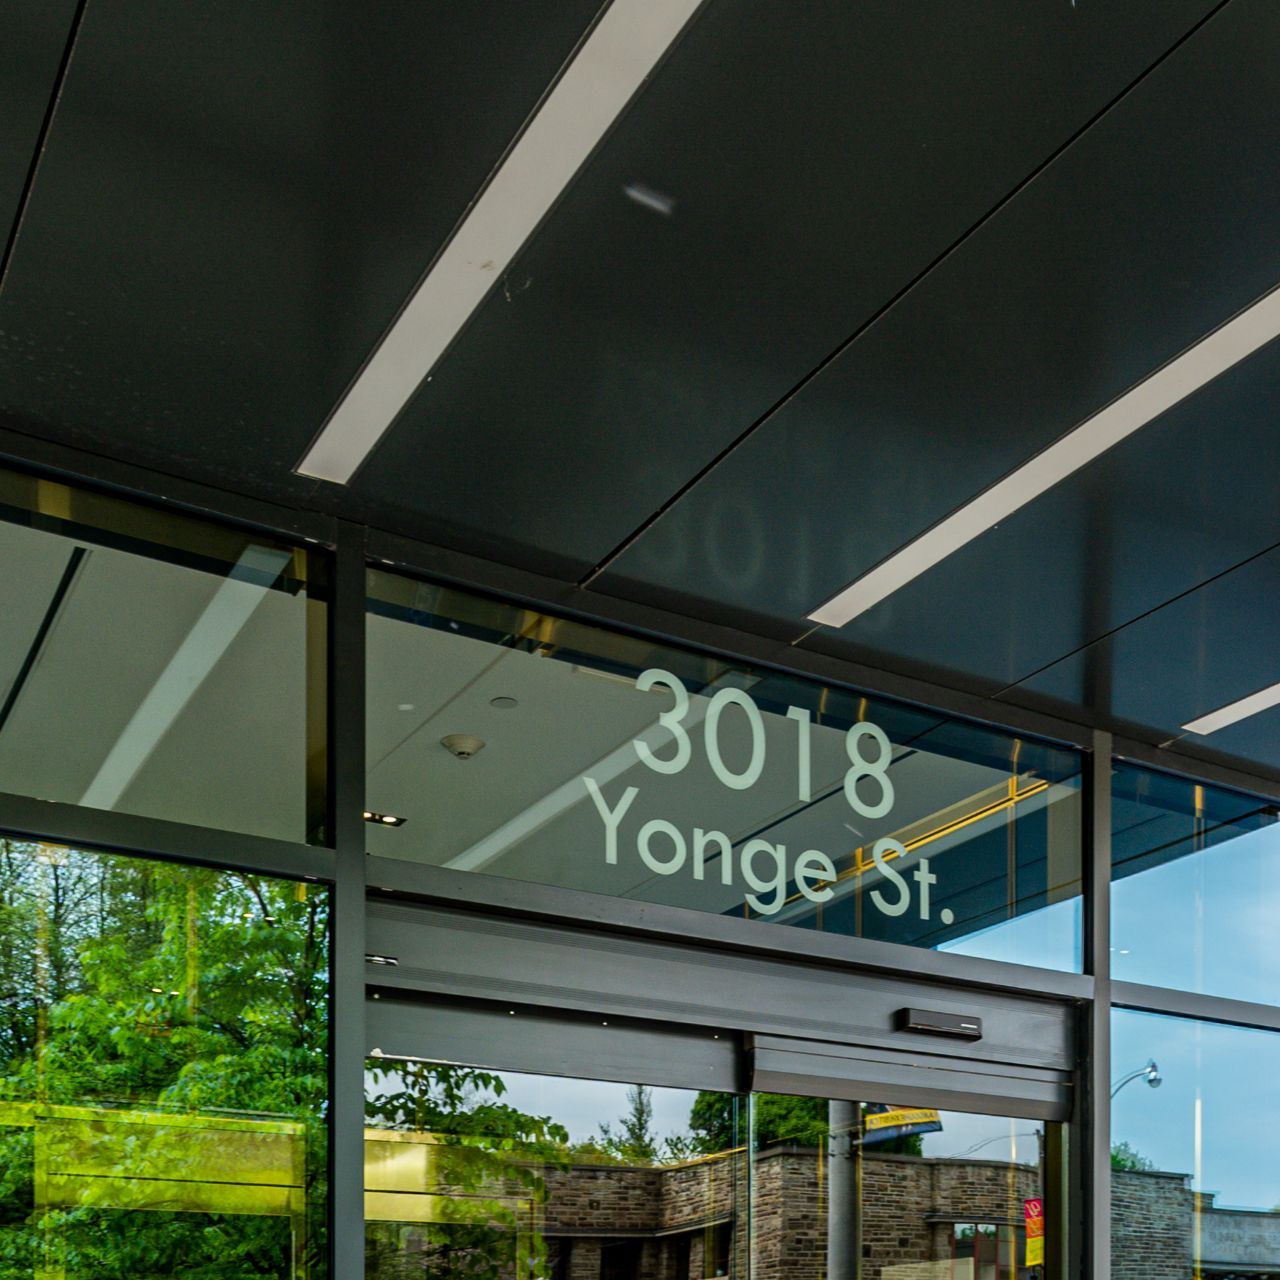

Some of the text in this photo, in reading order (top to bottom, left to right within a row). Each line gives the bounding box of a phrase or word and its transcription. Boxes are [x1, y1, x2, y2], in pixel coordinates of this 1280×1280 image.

[632, 669, 894, 819] 3018
[583, 777, 955, 925] Yonge St.
